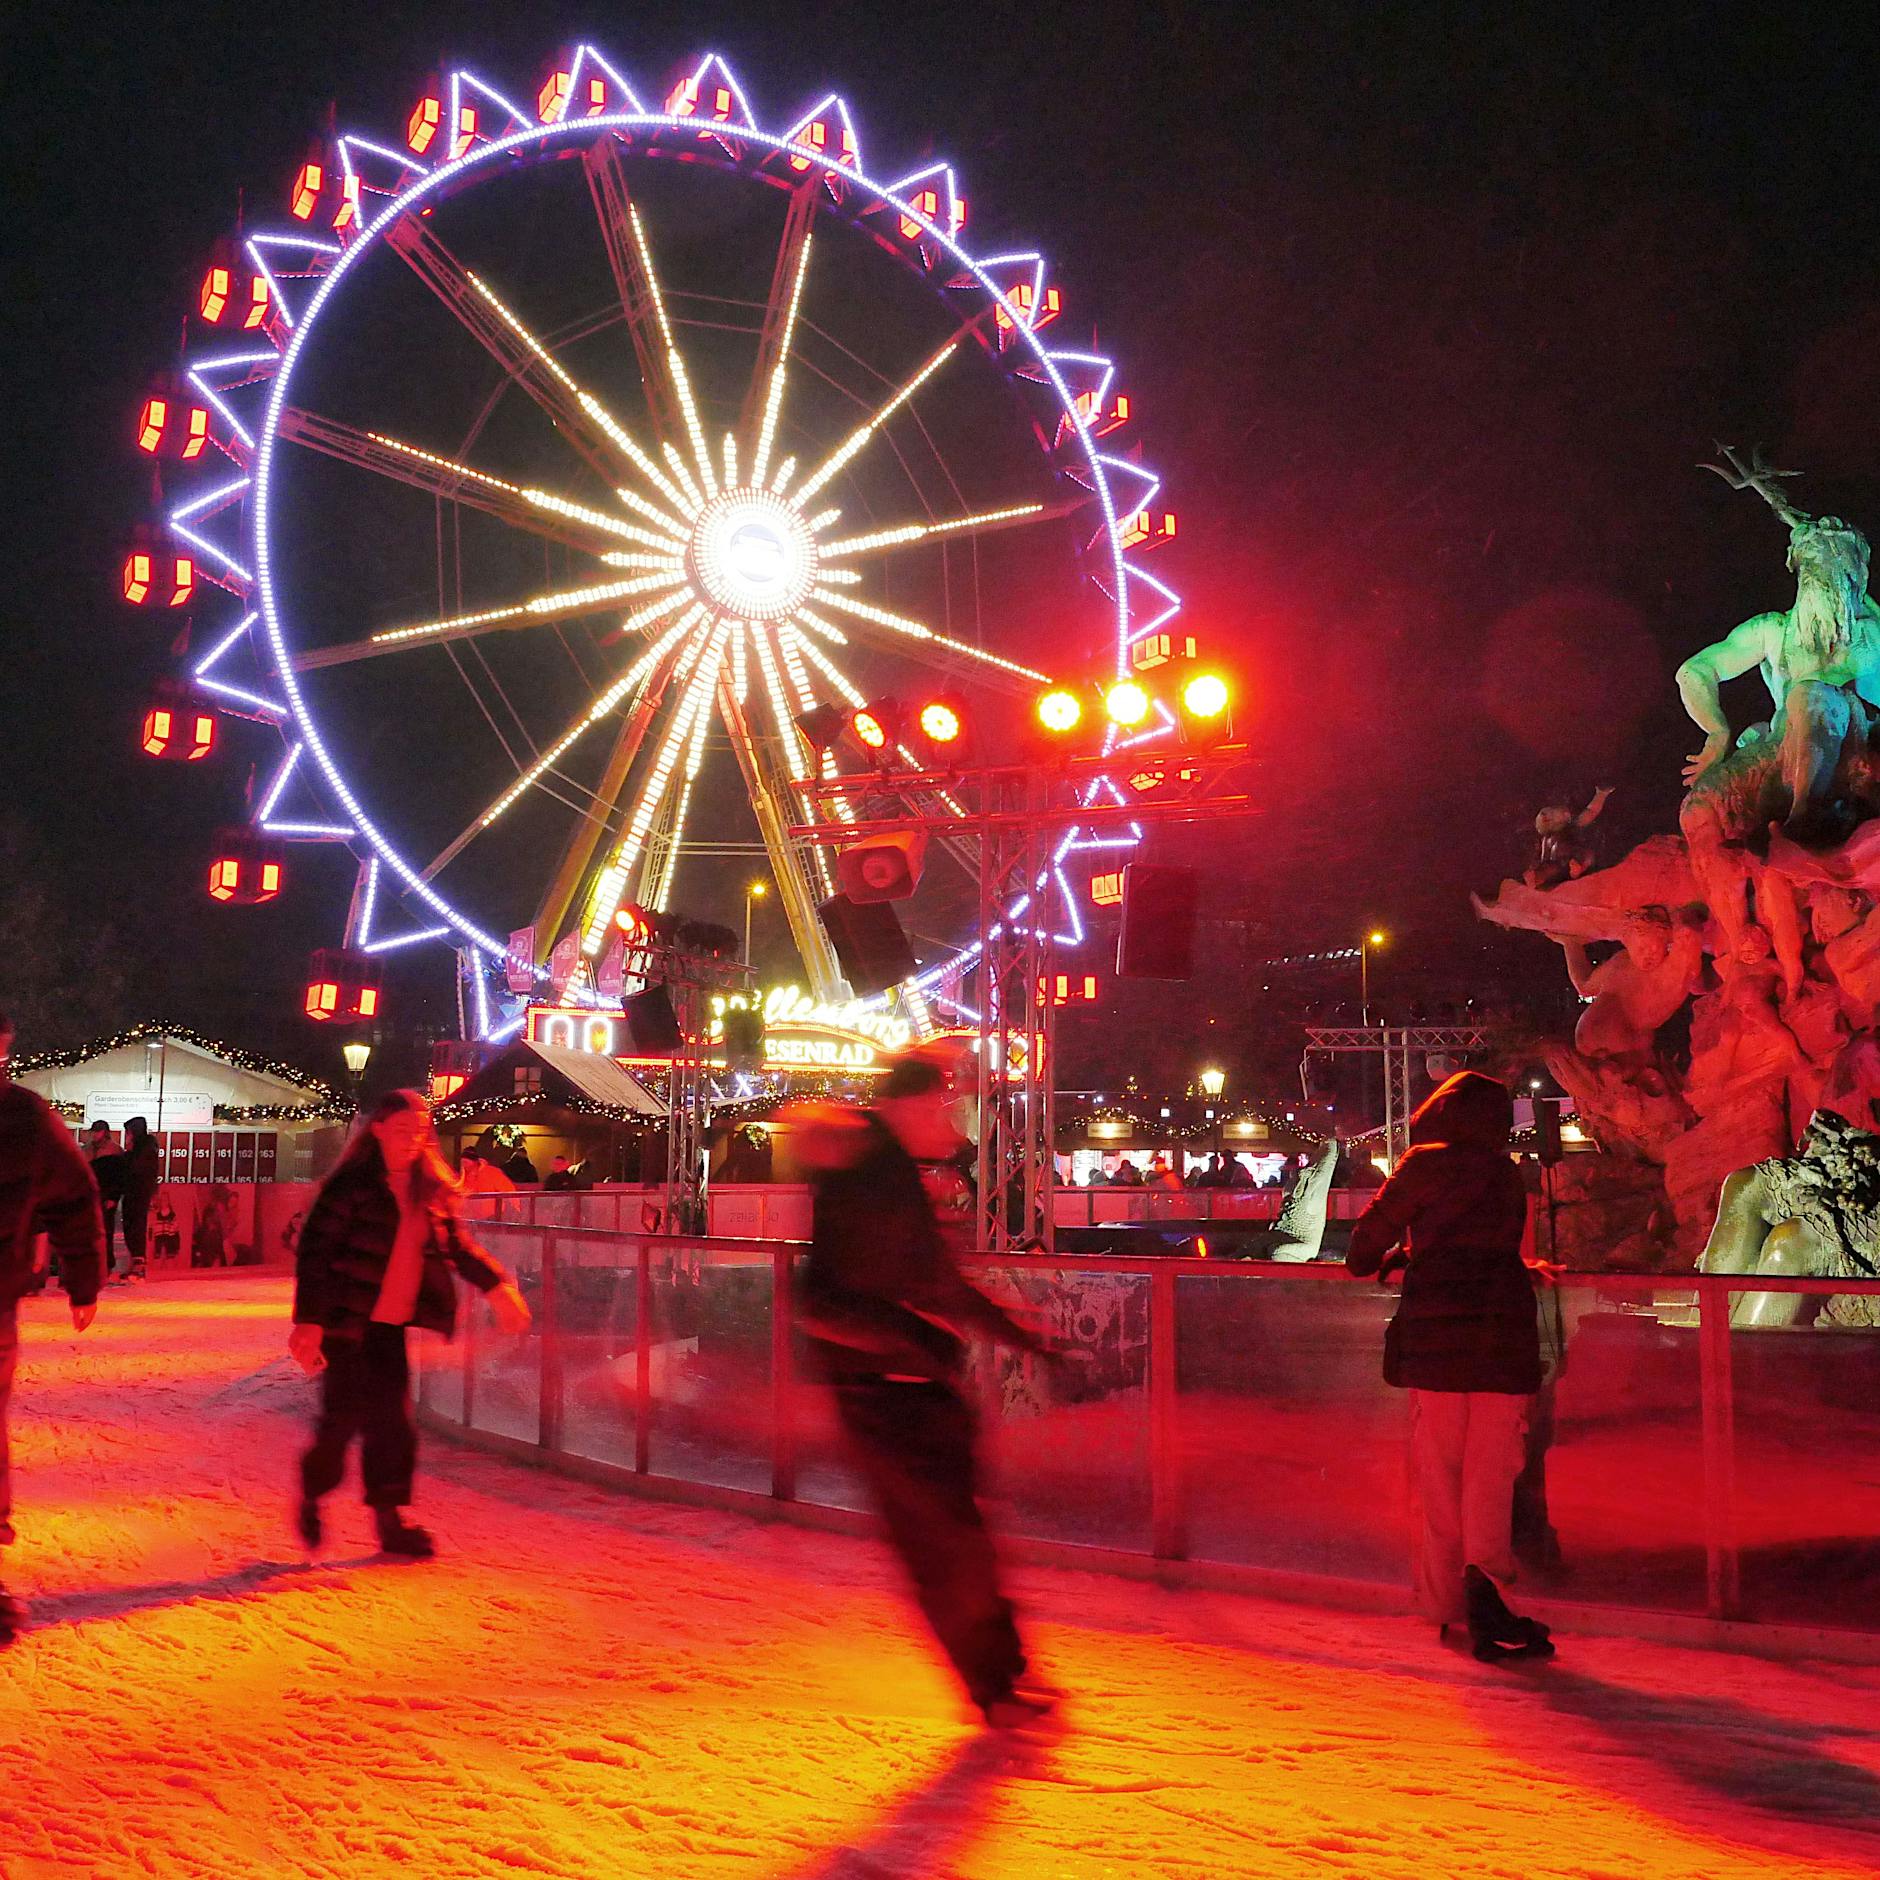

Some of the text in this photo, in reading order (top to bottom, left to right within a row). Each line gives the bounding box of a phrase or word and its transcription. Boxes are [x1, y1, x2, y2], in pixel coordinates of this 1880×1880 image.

[763, 1038, 874, 1065] ESENRAD
[171, 1149, 188, 1158] 150
[194, 1149, 210, 1158] 151
[216, 1149, 232, 1158] 161
